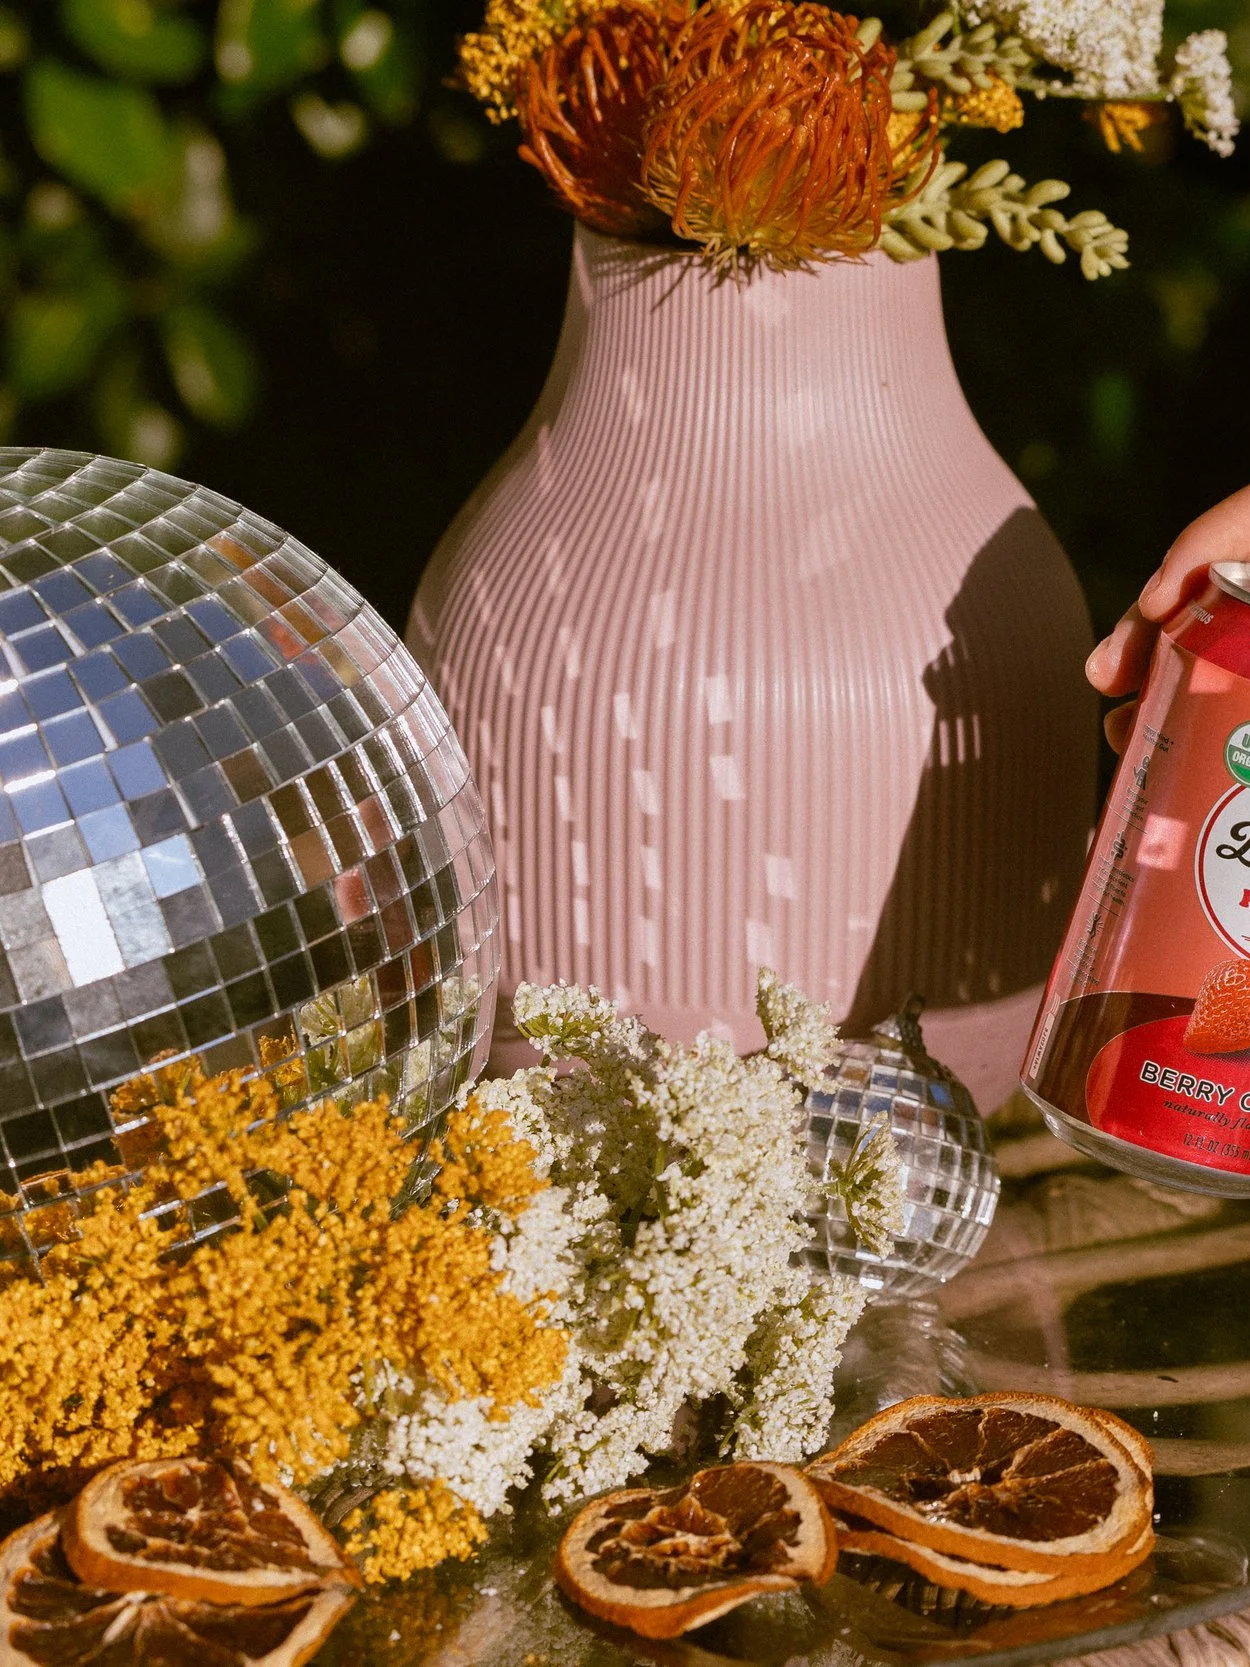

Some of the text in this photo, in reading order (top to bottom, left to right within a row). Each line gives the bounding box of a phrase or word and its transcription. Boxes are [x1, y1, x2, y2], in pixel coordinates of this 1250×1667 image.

[1139, 1060, 1234, 1106] BERRY
[1163, 1098, 1231, 1128] naturally
[1183, 1133, 1194, 1146] 12
[1220, 1141, 1239, 1158] (355
